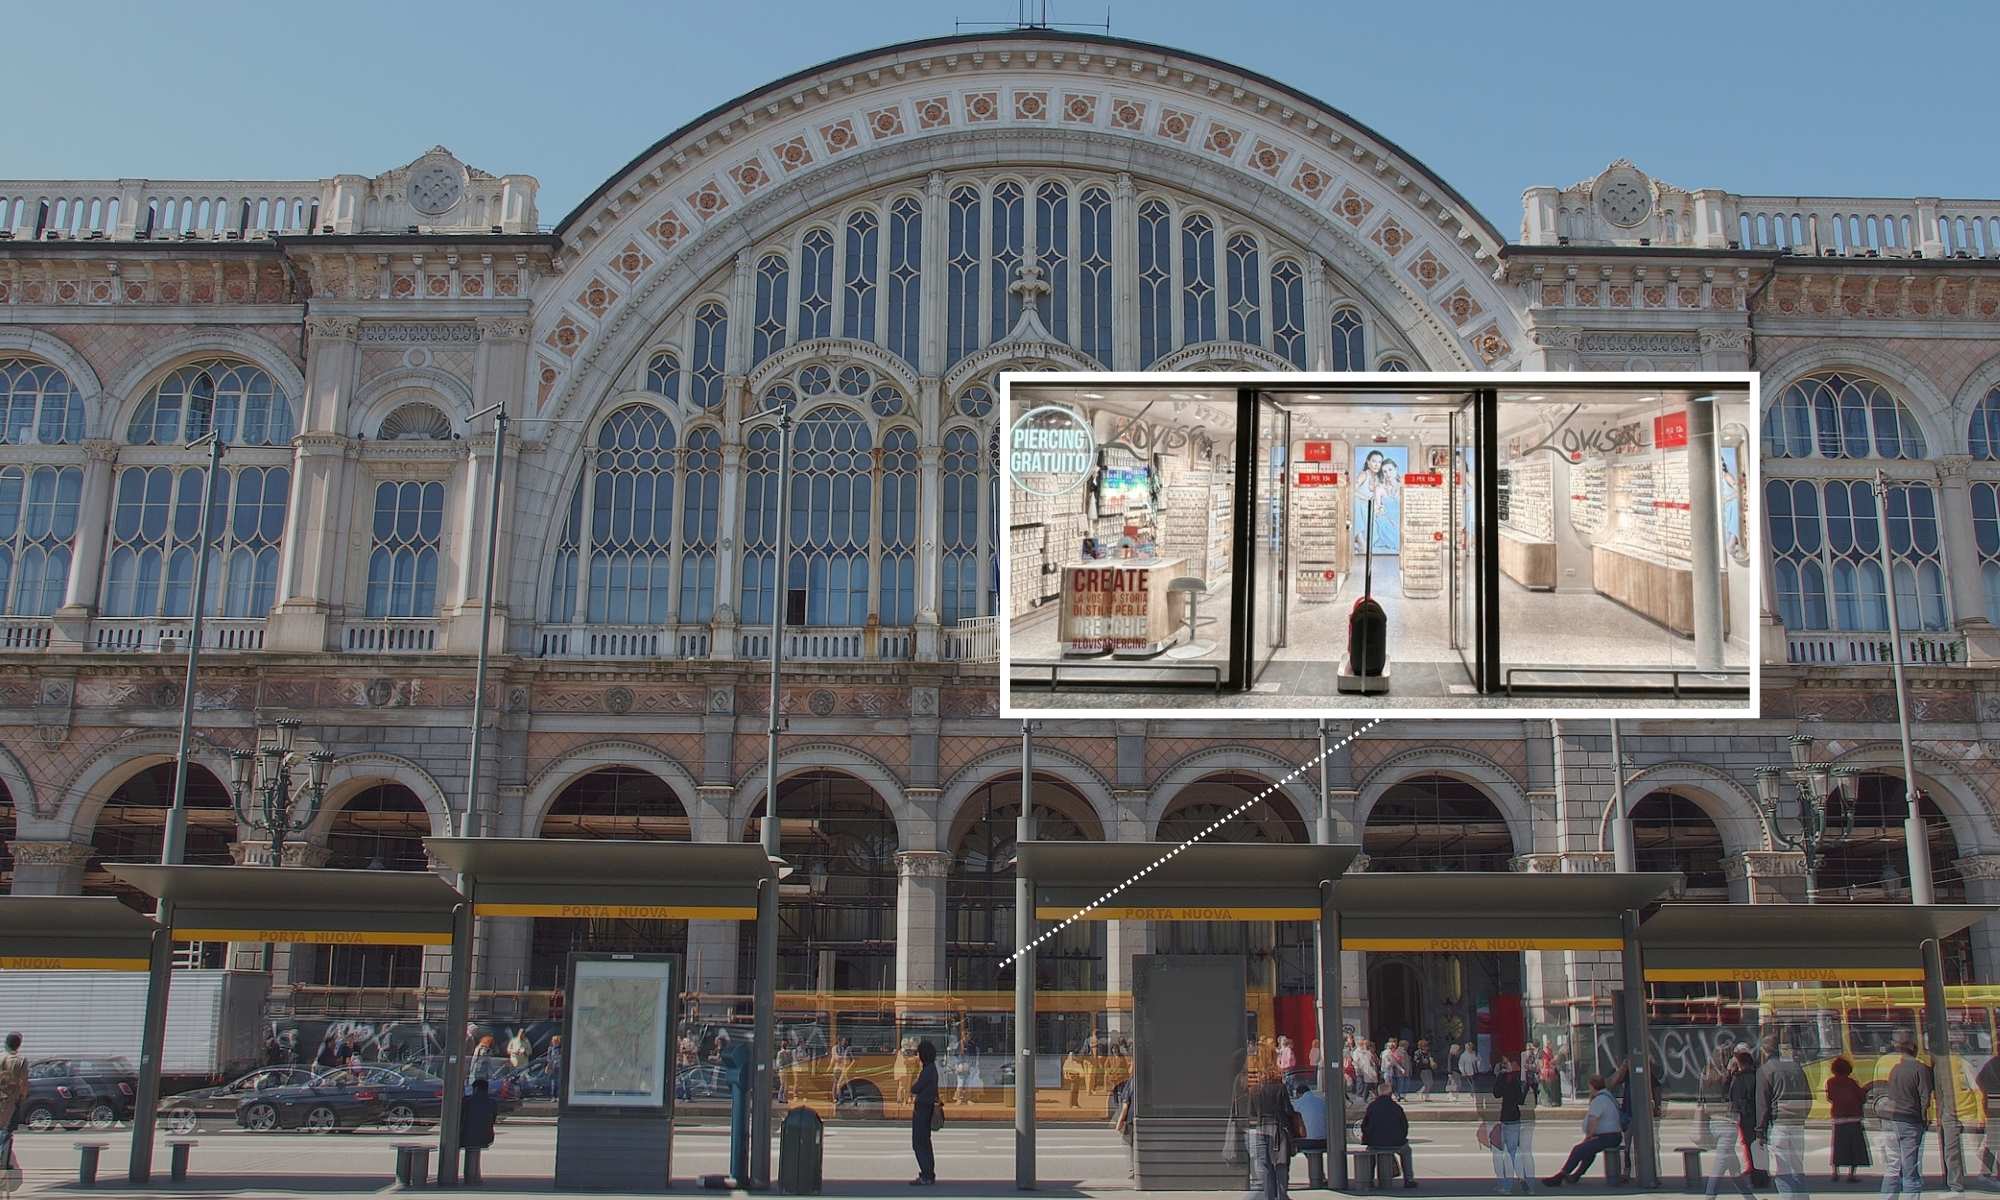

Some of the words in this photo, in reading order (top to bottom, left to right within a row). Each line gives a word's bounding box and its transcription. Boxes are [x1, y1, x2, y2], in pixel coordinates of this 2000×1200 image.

[1014, 428, 1084, 449] PIERCING
[1011, 451, 1086, 473] GRATUITO
[1074, 569, 1148, 592] CREATE
[1120, 593, 1147, 603] STORIA
[1073, 605, 1083, 616] DI
[1115, 605, 1134, 616] PER
[1136, 605, 1147, 616] LE
[561, 906, 609, 917] PORTA
[618, 907, 668, 917] NUOVA
[1125, 909, 1173, 919] PORTA
[1182, 909, 1232, 919] NUOVA
[259, 931, 306, 942] PORTA
[315, 932, 364, 943] NUOVA
[1430, 939, 1479, 950] PORTA
[1487, 939, 1536, 950] NUOVA
[12, 958, 62, 969] NUOVA
[1732, 969, 1780, 980] PORTA
[1788, 970, 1837, 980] NUOVA
